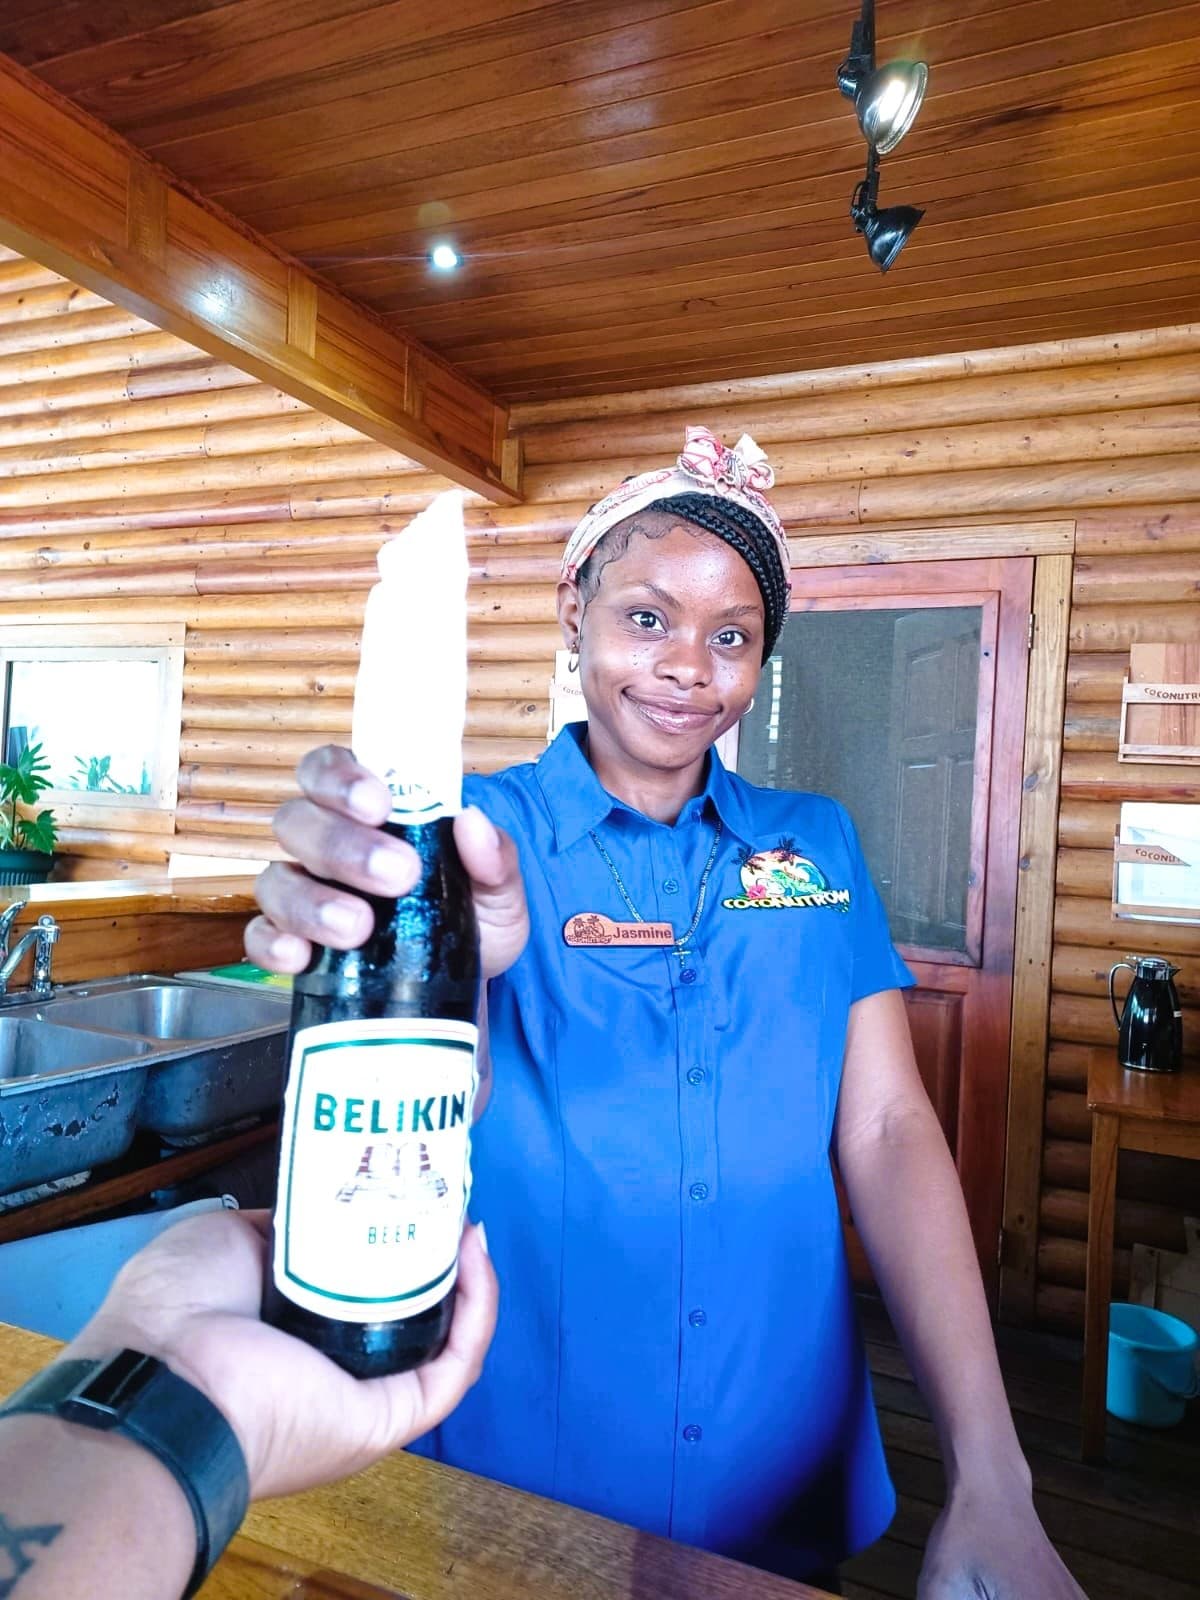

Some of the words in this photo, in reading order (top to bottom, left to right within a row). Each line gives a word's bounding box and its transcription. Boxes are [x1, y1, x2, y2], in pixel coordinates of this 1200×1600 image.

[1144, 687, 1200, 700] COCONUTR
[613, 927, 672, 939] Jasmine
[313, 1090, 466, 1134] BELIKIN
[368, 1223, 416, 1244] BEER
